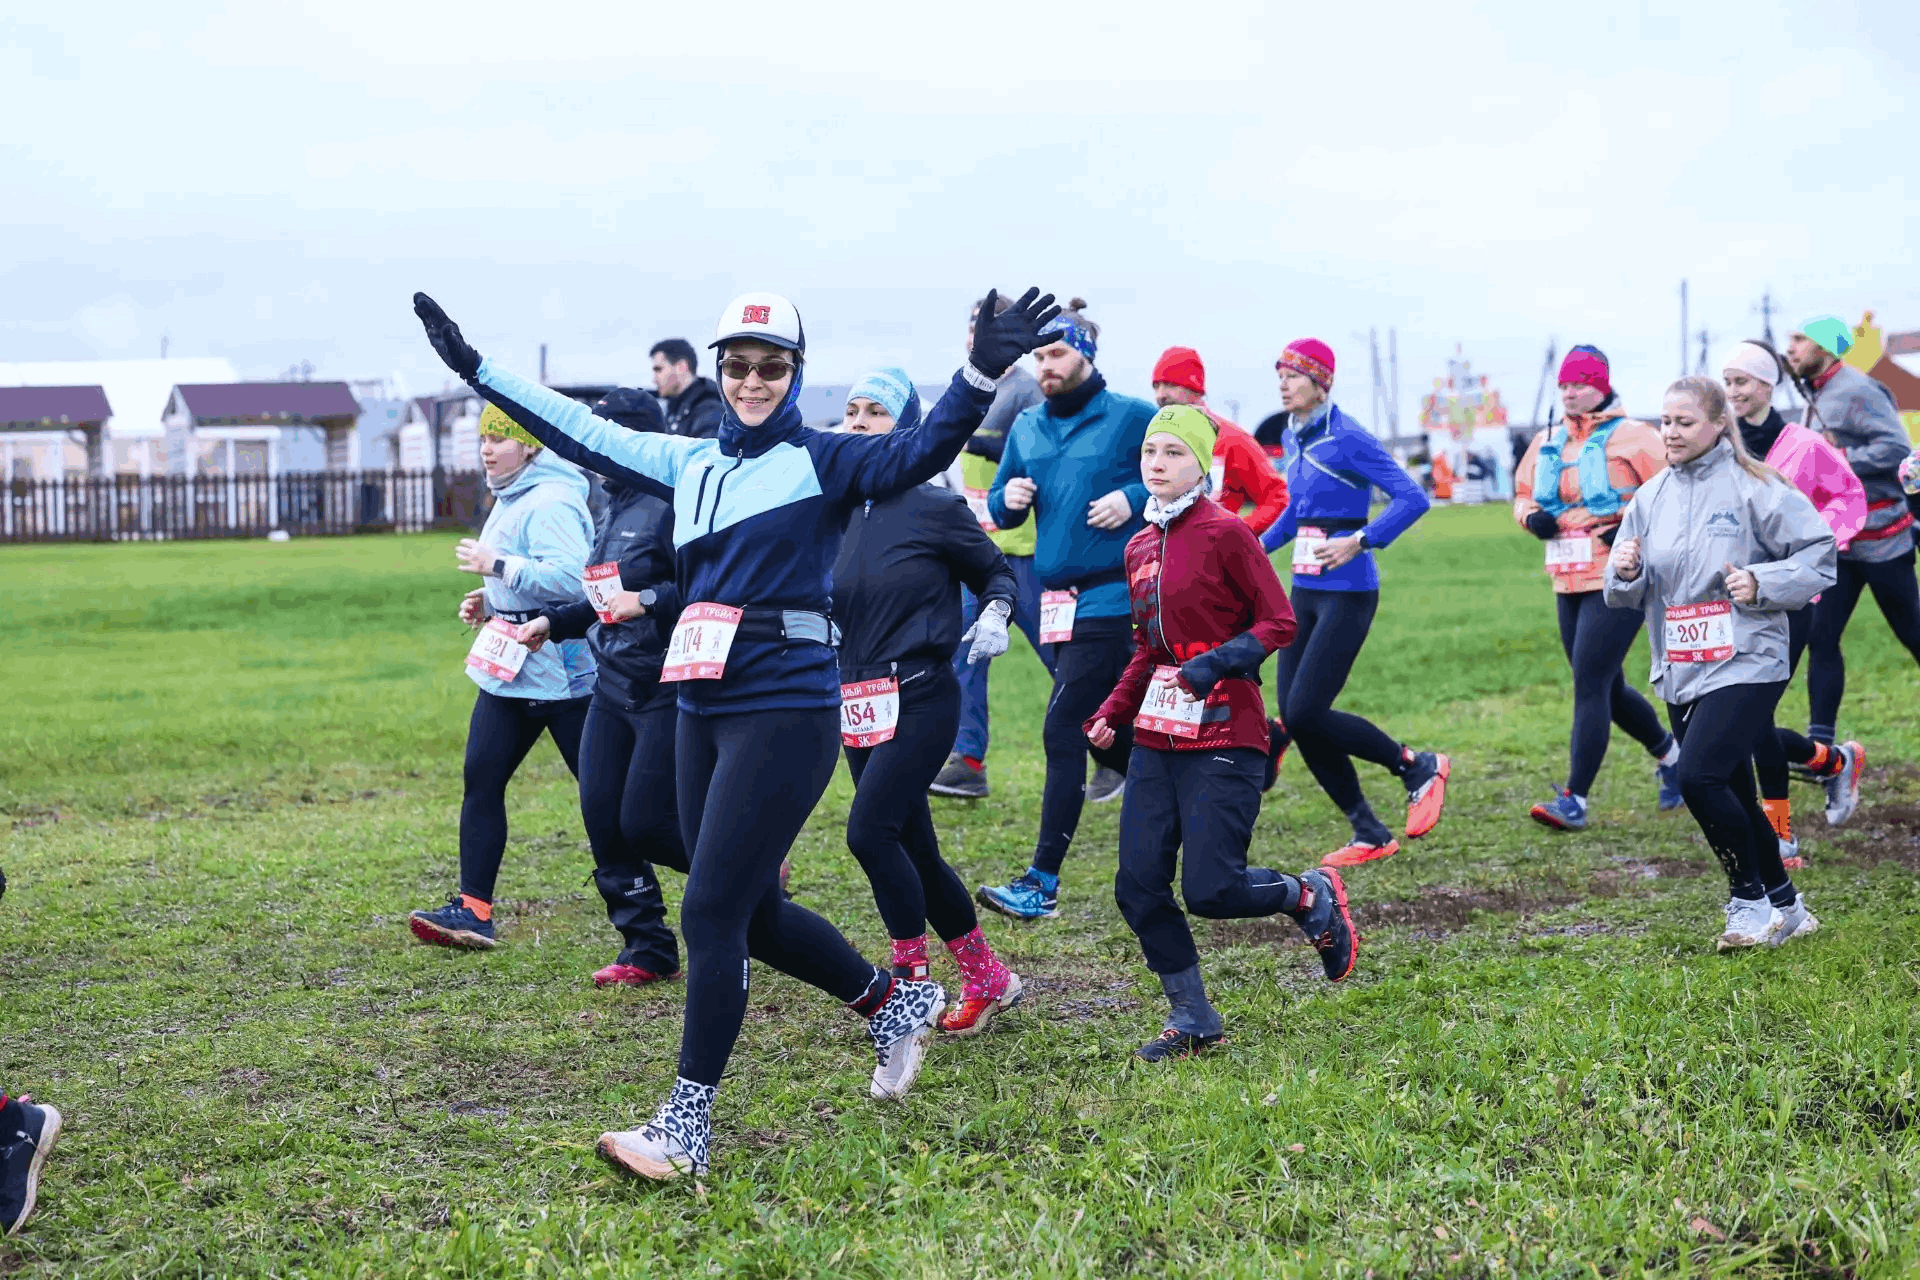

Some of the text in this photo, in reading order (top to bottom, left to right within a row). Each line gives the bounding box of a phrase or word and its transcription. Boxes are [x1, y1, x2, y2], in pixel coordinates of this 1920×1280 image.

[682, 626, 703, 655] 174
[1677, 621, 1709, 643] 207
[484, 635, 509, 659] 221
[844, 701, 876, 727] 154
